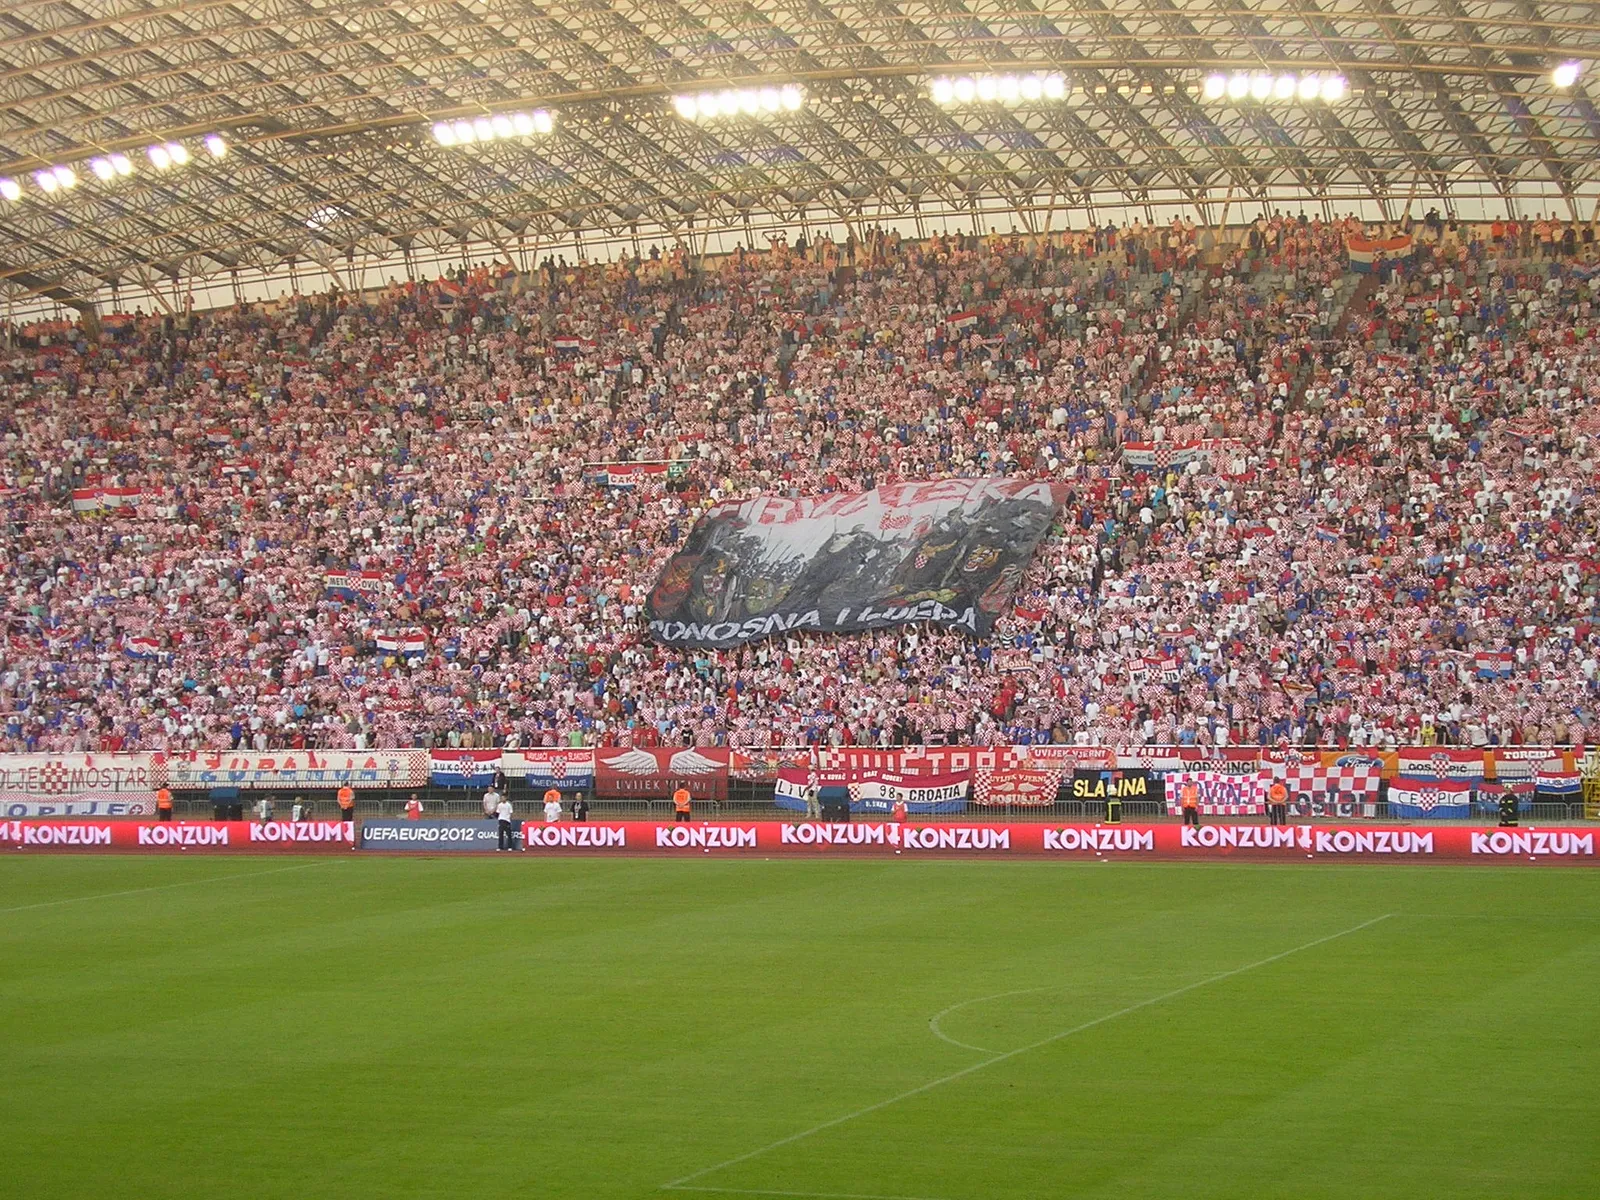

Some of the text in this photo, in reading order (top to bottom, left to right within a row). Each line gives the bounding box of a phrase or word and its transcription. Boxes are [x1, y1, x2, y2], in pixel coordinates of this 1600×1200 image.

[1503, 750, 1556, 759] TORCIDA
[72, 767, 148, 788] MOSTAR
[908, 785, 961, 801] CROATIA
[24, 826, 111, 845] KONZUM
[138, 826, 229, 845] KONZUM
[250, 822, 342, 842] KONZUM
[528, 826, 626, 847] KONZUM
[656, 826, 757, 847] KONZUM
[781, 823, 885, 844] KONZUM
[903, 828, 1010, 849] KONZUM
[1044, 829, 1153, 850] KONZUM
[1181, 825, 1295, 847] KONZUM
[1315, 831, 1434, 853] KONZUM
[1471, 832, 1594, 854] KONZUM
